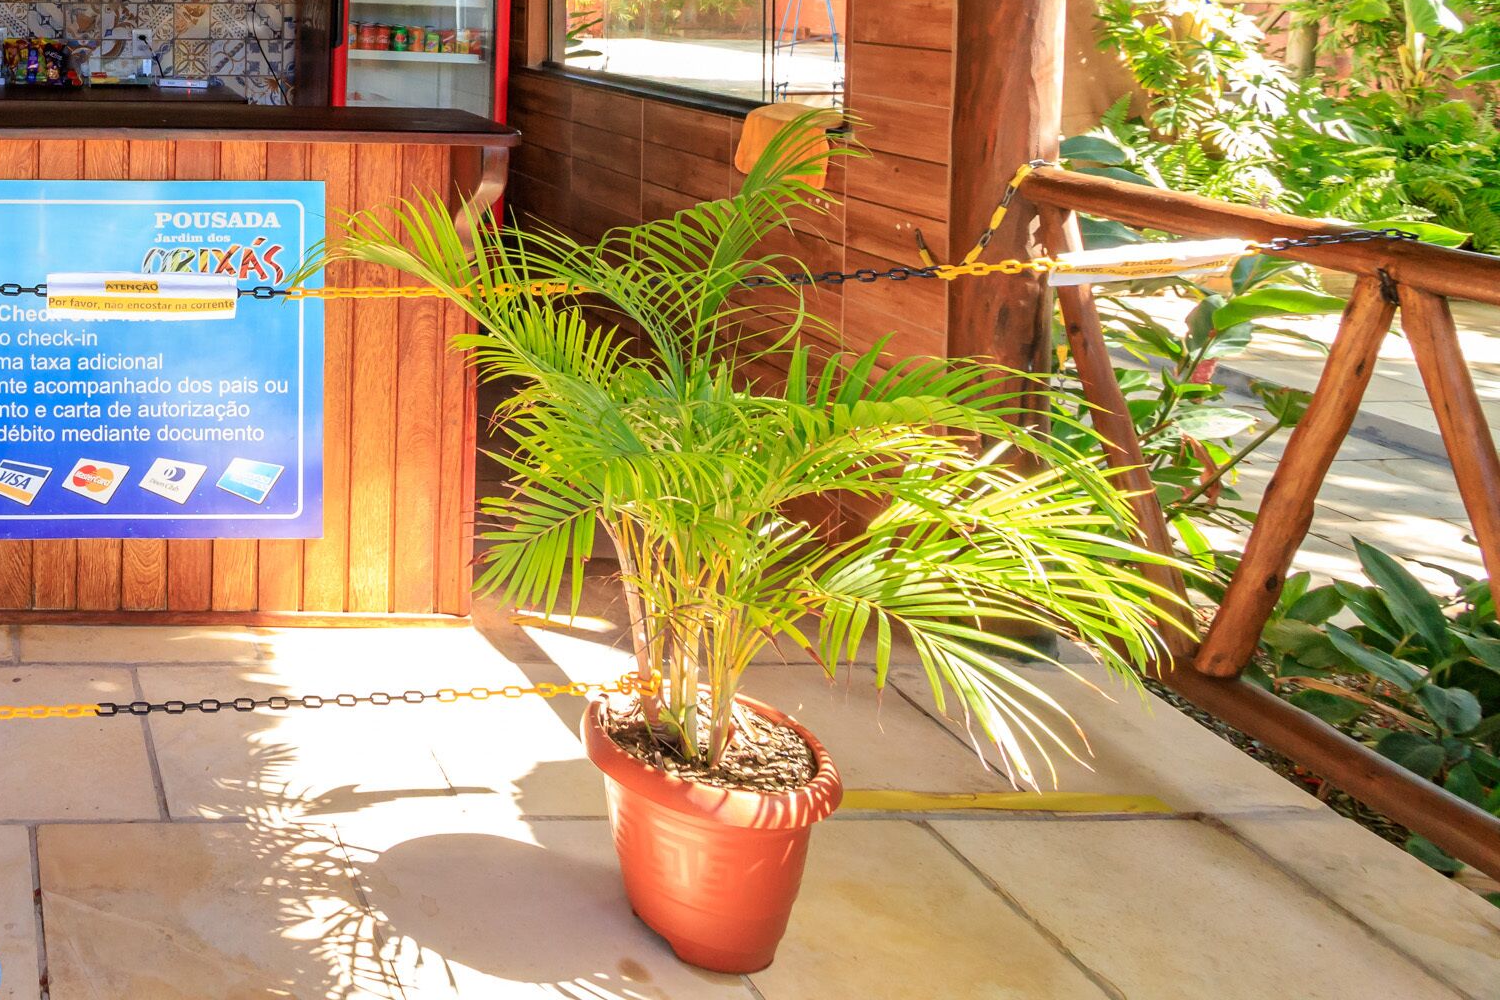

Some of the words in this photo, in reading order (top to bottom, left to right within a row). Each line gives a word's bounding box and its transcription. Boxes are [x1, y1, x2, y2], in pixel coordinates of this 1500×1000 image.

[154, 212, 281, 228] POUSADA
[154, 233, 204, 243] Jardim
[208, 233, 231, 243] dos
[143, 236, 284, 286] ORIXÁS
[106, 282, 158, 293] ATENÇÃO
[49, 298, 66, 306] Por
[70, 298, 100, 309] favor,
[128, 301, 172, 310] encostar
[191, 300, 235, 310] corrente
[17, 329, 98, 346] check-in
[30, 355, 71, 370] taxa
[77, 353, 163, 370] adicional
[34, 378, 172, 398] acompanhado
[178, 378, 212, 394] dos
[219, 378, 258, 397] pais
[264, 381, 288, 394] ou
[34, 404, 47, 418] e
[53, 403, 101, 418] carta
[107, 400, 132, 418] de
[138, 400, 250, 422] autorização
[62, 425, 150, 442] mediante
[157, 425, 264, 442] documento
[0, 470, 32, 490] VISA
